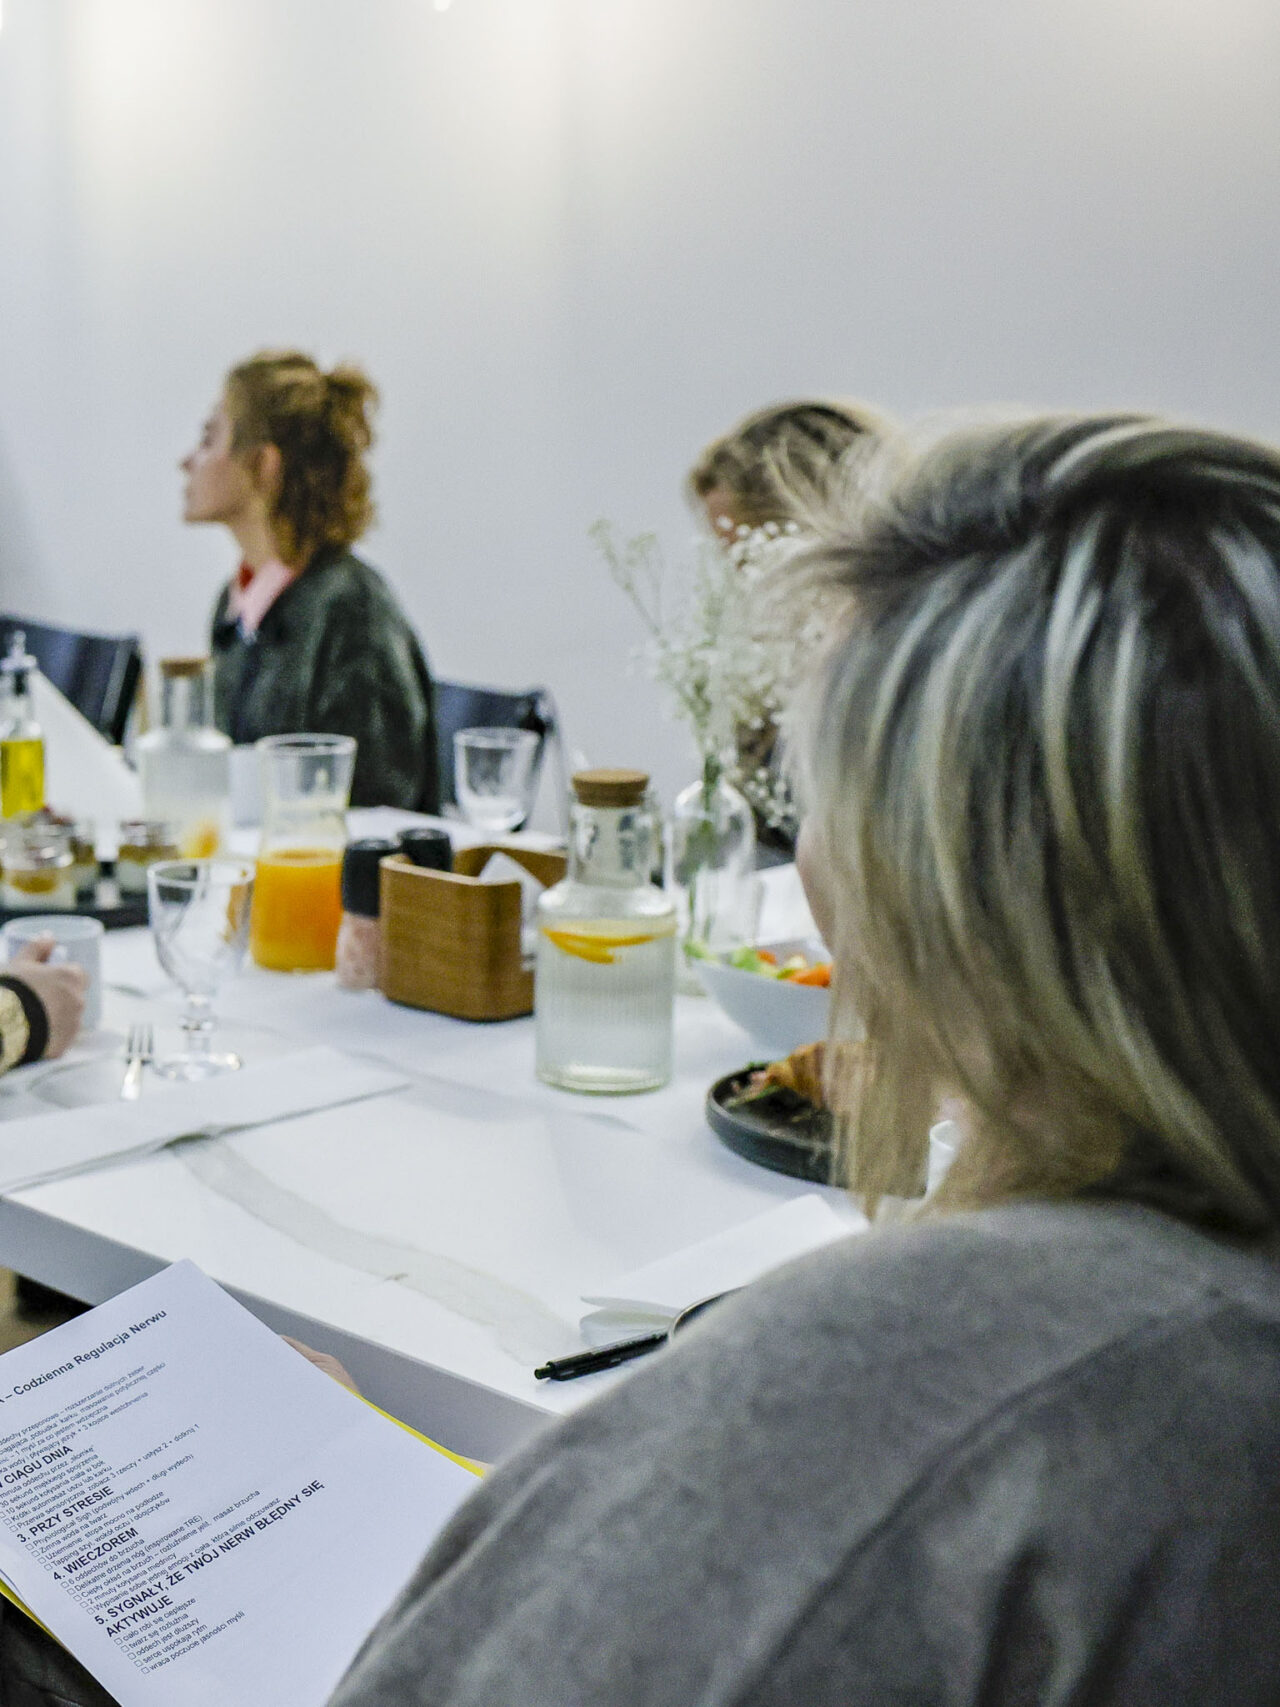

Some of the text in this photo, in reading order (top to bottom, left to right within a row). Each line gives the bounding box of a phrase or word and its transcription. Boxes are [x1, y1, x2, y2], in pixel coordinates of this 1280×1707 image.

[12, 1361, 75, 1395] Codzienna
[72, 1331, 131, 1365] Regulacja
[128, 1310, 167, 1334] Nerwu
[7, 1457, 26, 1469] wody
[36, 1438, 46, 1446] za
[44, 1433, 55, 1441] co
[3, 1459, 43, 1484] CIĄGU
[41, 1445, 73, 1465] DNIA
[5, 1506, 16, 1515] 10
[14, 1494, 40, 1511] sekund
[90, 1459, 106, 1470] bok
[8, 1487, 34, 1504] sekund
[65, 1453, 99, 1474] spojrzenia
[21, 1470, 51, 1488] oddechu
[49, 1460, 69, 1474] przez
[10, 1508, 32, 1522] Krótki
[65, 1481, 83, 1493] uszu
[81, 1475, 94, 1484] lub
[92, 1465, 113, 1478] karku
[16, 1511, 46, 1529] Przerwa
[86, 1475, 111, 1491] zobacz
[115, 1460, 138, 1476] rzeczy
[16, 1485, 114, 1543] 3. PRZY STRESIE
[32, 1519, 77, 1547] Physiological
[74, 1511, 93, 1523] Sigh
[123, 1481, 146, 1496] wdech
[151, 1469, 168, 1481] długi
[83, 1525, 104, 1539] stopa
[102, 1512, 126, 1528] mocno
[125, 1507, 136, 1516] na
[134, 1491, 164, 1511] podłodze
[38, 1512, 108, 1554] Zimna woda na twarz
[50, 1549, 80, 1567] Tapping
[94, 1527, 115, 1543] wokół
[113, 1520, 131, 1532] oczu
[53, 1526, 139, 1580] 4. WIECZOREM
[73, 1571, 107, 1592] Delikatne
[130, 1549, 146, 1560] nóg
[143, 1525, 186, 1553] (inspirowane
[182, 1514, 203, 1528] TRE)
[80, 1583, 104, 1598] Ciepły
[102, 1572, 122, 1587] okład
[121, 1567, 132, 1576] na
[129, 1554, 154, 1571] brzuch
[232, 1490, 261, 1509] brzucha
[93, 1479, 325, 1625] 5. SYGNAŁY, ŻE TWÓJ NERW BŁĘDNY SIĘ
[93, 1589, 130, 1611] Wypisanie
[128, 1579, 148, 1593] sobie
[146, 1568, 169, 1584] jednej
[166, 1555, 190, 1571] emocji
[245, 1497, 281, 1522] odczuwasz
[74, 1559, 109, 1582] oddechów
[108, 1553, 119, 1562] do
[116, 1538, 145, 1557] brzucha
[93, 1586, 118, 1601] minuty
[146, 1552, 177, 1572] miednicy
[105, 1594, 174, 1638] AKTYWUJE
[127, 1635, 149, 1649] twarz
[147, 1629, 160, 1639] się
[138, 1620, 153, 1633] robi
[151, 1616, 164, 1625] się
[163, 1597, 196, 1619] cieplejsze
[135, 1639, 162, 1656] oddech
[160, 1631, 174, 1644] jest
[142, 1623, 208, 1664] serce uspokaja rytm
[148, 1611, 245, 1671] wraca poczucie jasności myśli
